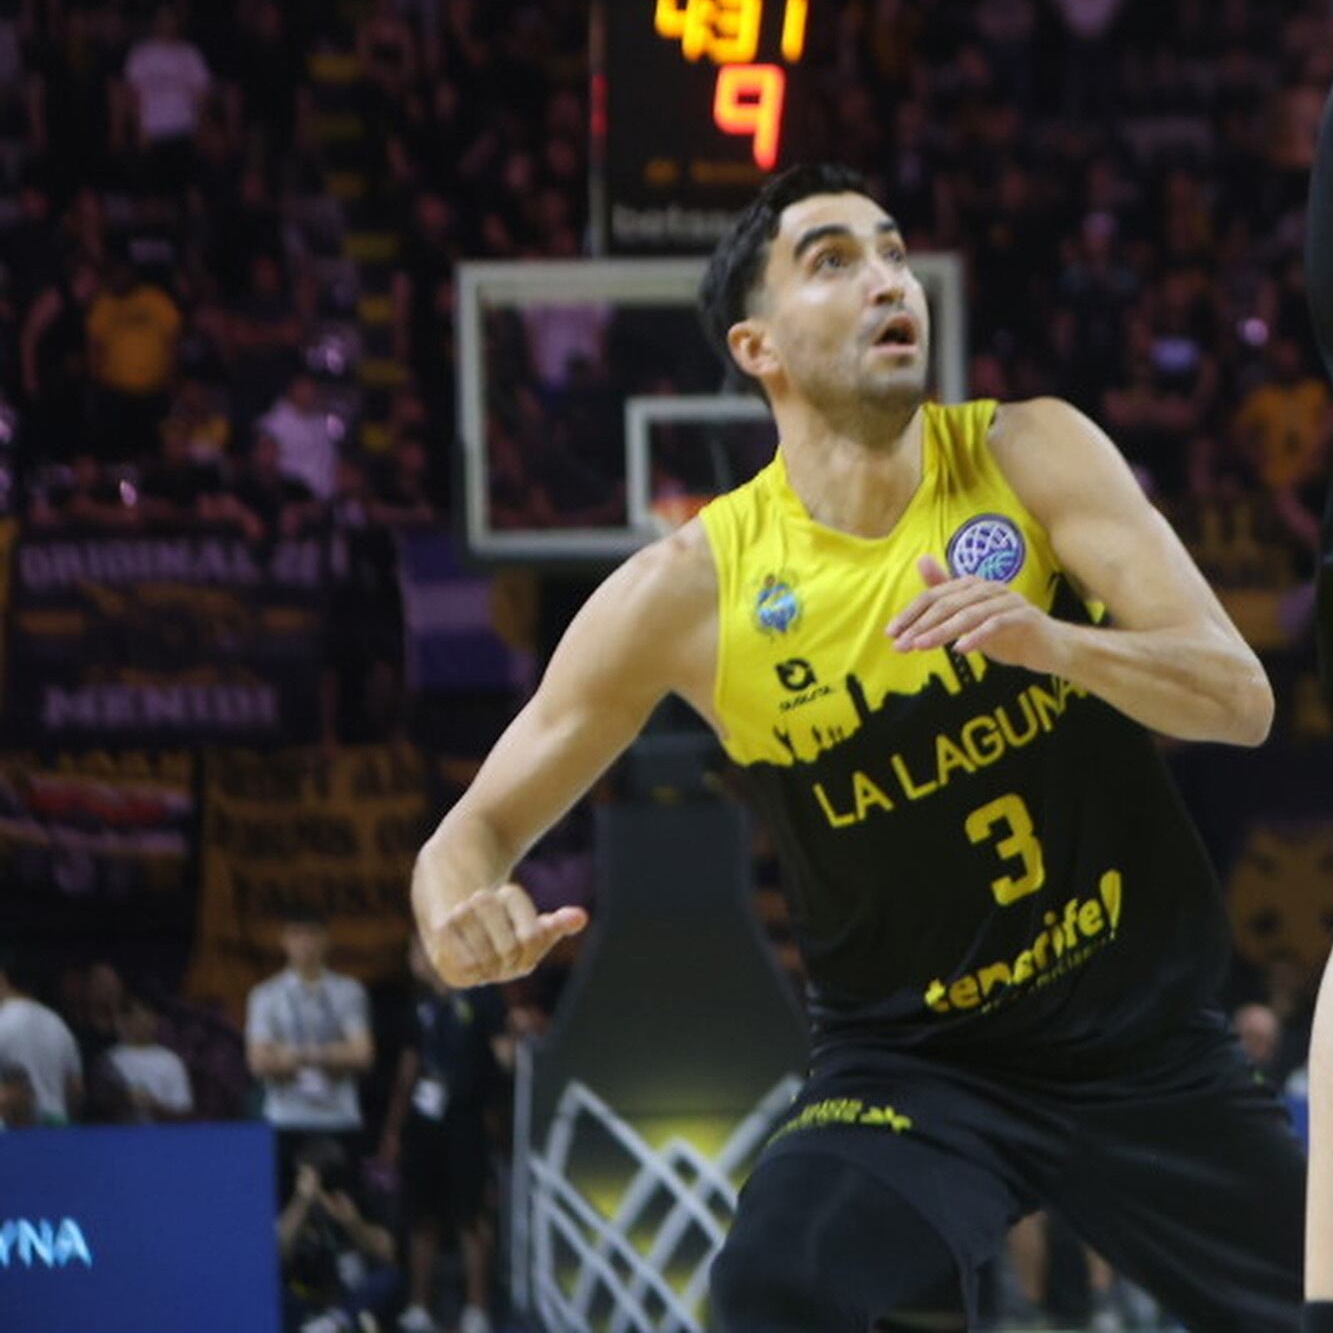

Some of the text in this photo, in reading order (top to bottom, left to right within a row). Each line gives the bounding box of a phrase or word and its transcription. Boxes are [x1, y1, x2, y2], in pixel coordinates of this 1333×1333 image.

[713, 63, 787, 171] 9
[812, 770, 896, 829] LA
[963, 791, 1046, 907] 3
[923, 867, 1124, 1013] tenerife!
